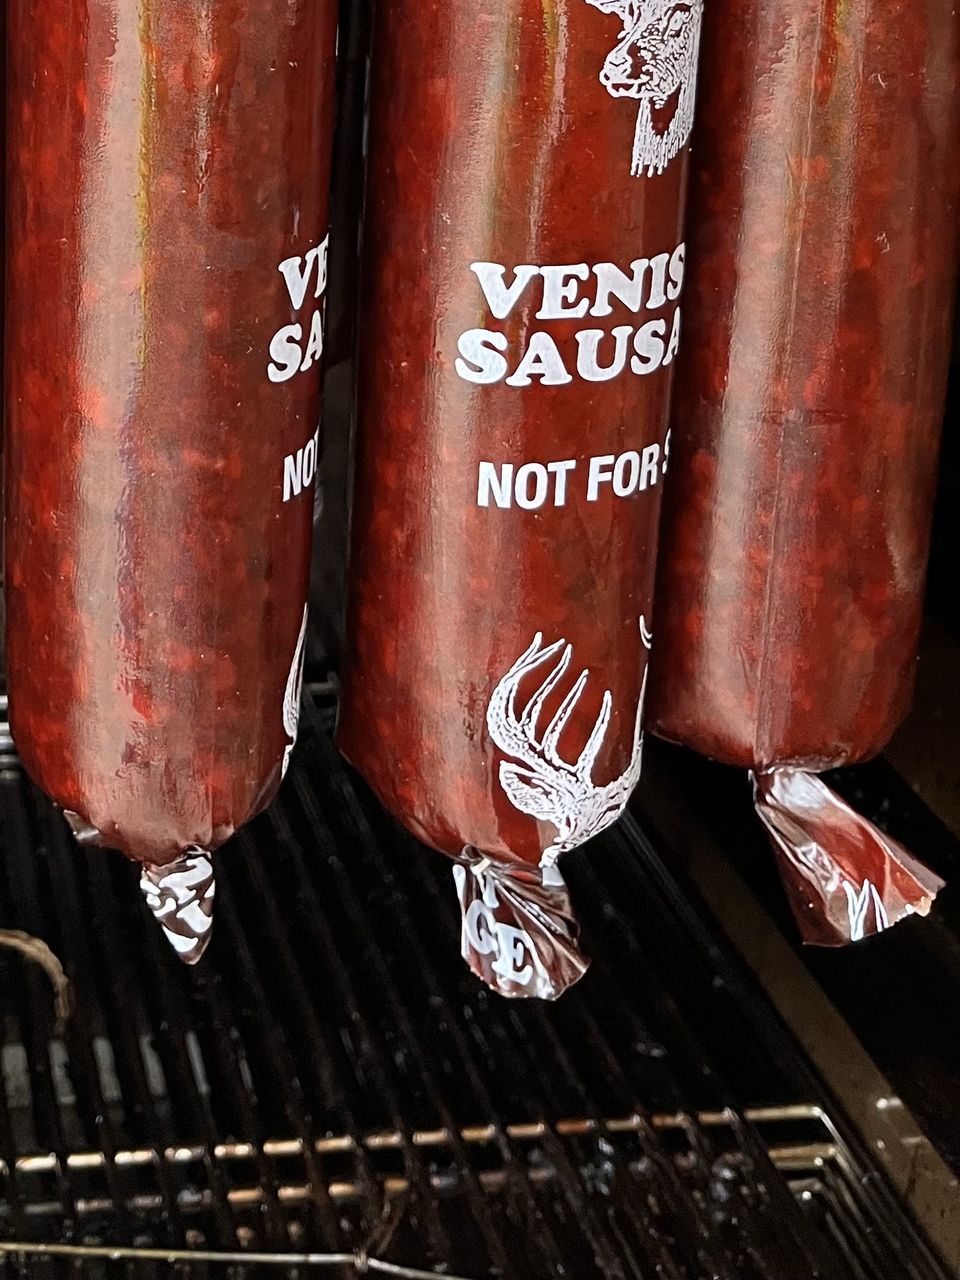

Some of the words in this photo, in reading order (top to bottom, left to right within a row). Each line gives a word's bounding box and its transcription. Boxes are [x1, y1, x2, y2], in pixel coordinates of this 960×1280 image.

[470, 242, 686, 320] VENIS
[267, 309, 323, 382] SA
[455, 307, 681, 387] SAUSA
[477, 460, 576, 510] NOT
[586, 442, 660, 501] FOR
